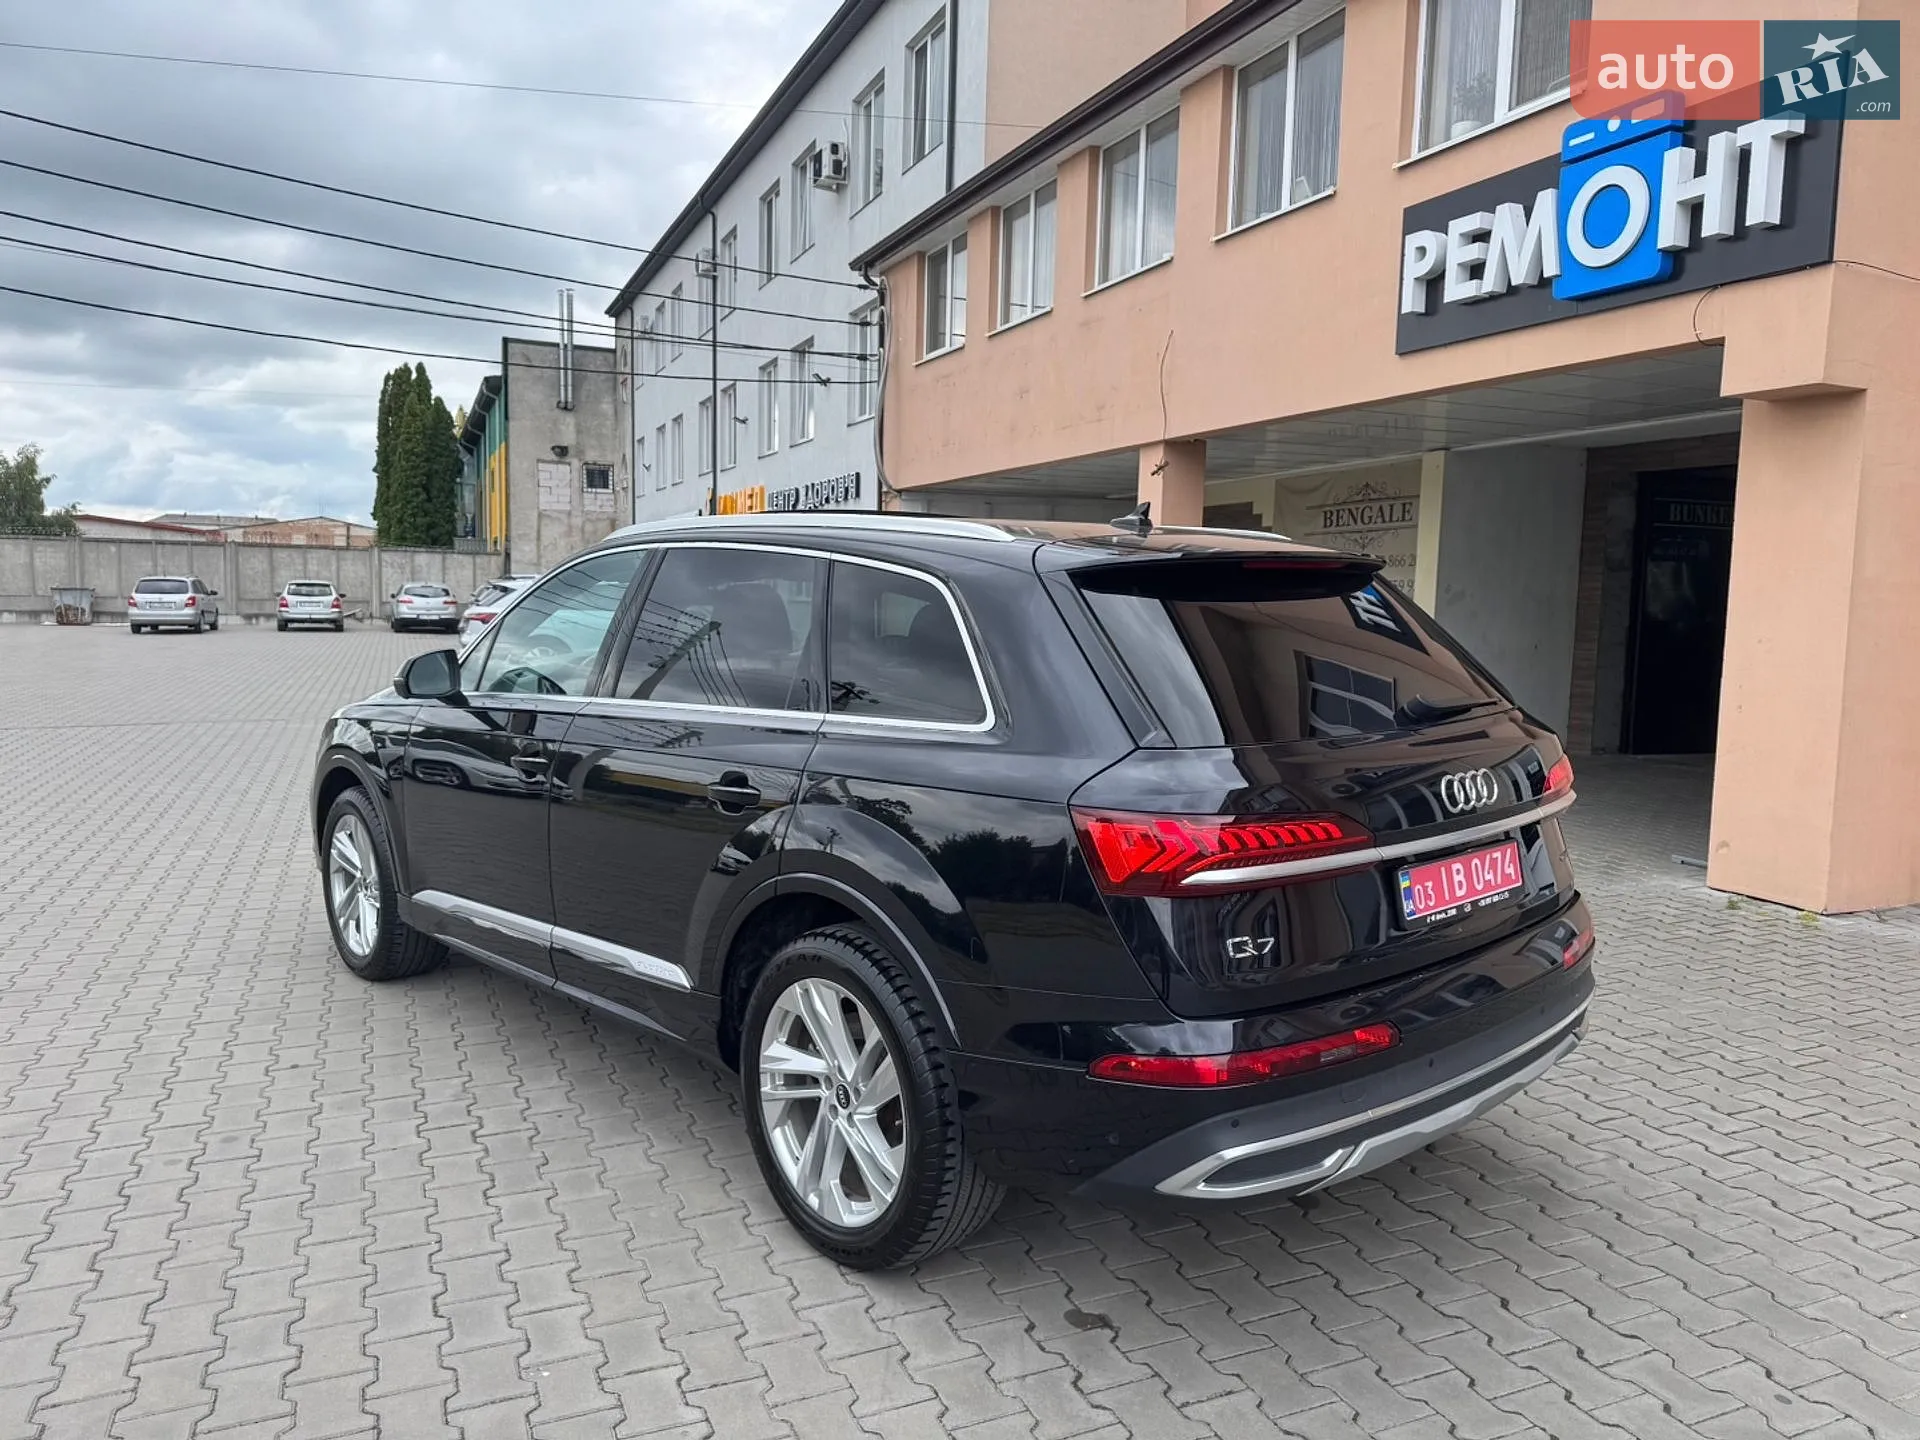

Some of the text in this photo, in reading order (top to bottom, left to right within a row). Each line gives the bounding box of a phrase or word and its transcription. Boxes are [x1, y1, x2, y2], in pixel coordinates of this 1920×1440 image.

[1400, 110, 1807, 315] РЕМОНТ
[1321, 501, 1414, 530] BENGALE
[1669, 502, 1732, 525] BUNKE
[1414, 880, 1436, 910] 03
[1470, 847, 1517, 892] 0474
[1226, 935, 1275, 959] Q7
